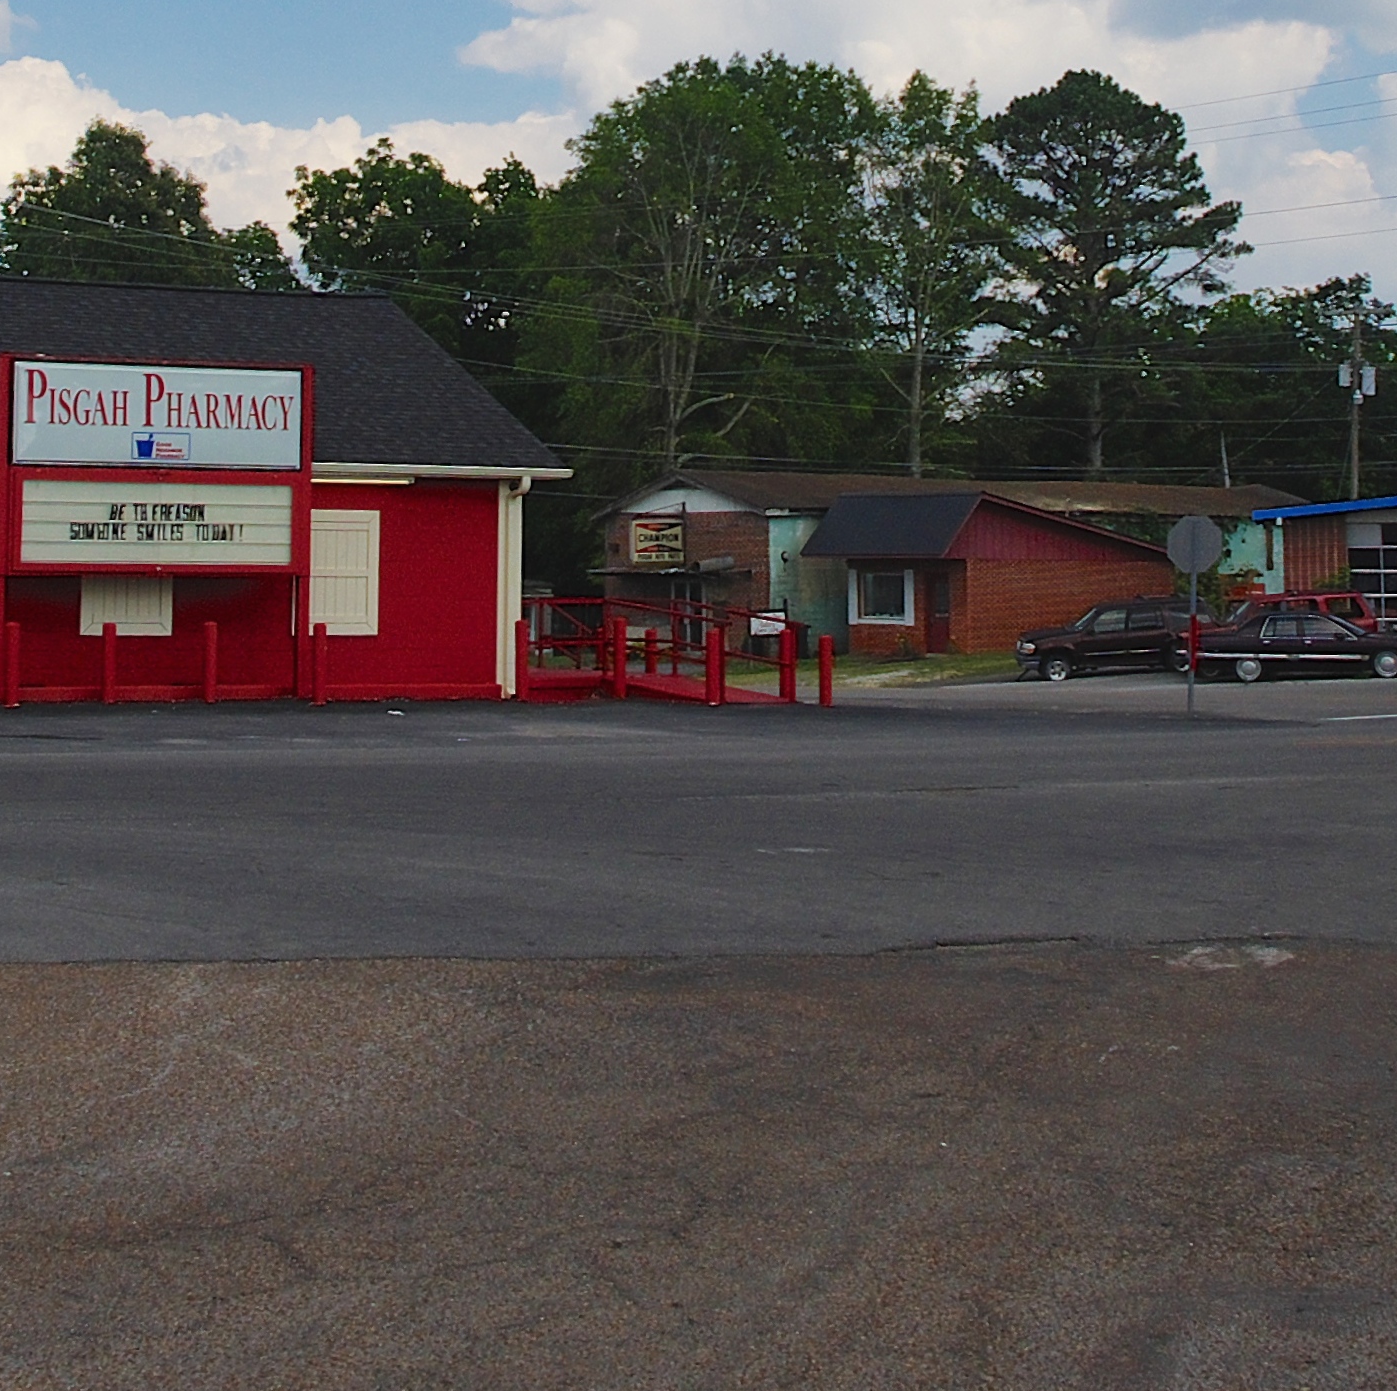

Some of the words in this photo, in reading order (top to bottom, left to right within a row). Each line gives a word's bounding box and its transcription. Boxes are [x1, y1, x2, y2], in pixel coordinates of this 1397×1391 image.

[24, 368, 130, 427] PISGAH
[142, 373, 295, 431] PHARMACY
[109, 504, 127, 522] BE
[136, 523, 184, 542] SMILES
[638, 533, 679, 543] CHAMPION
